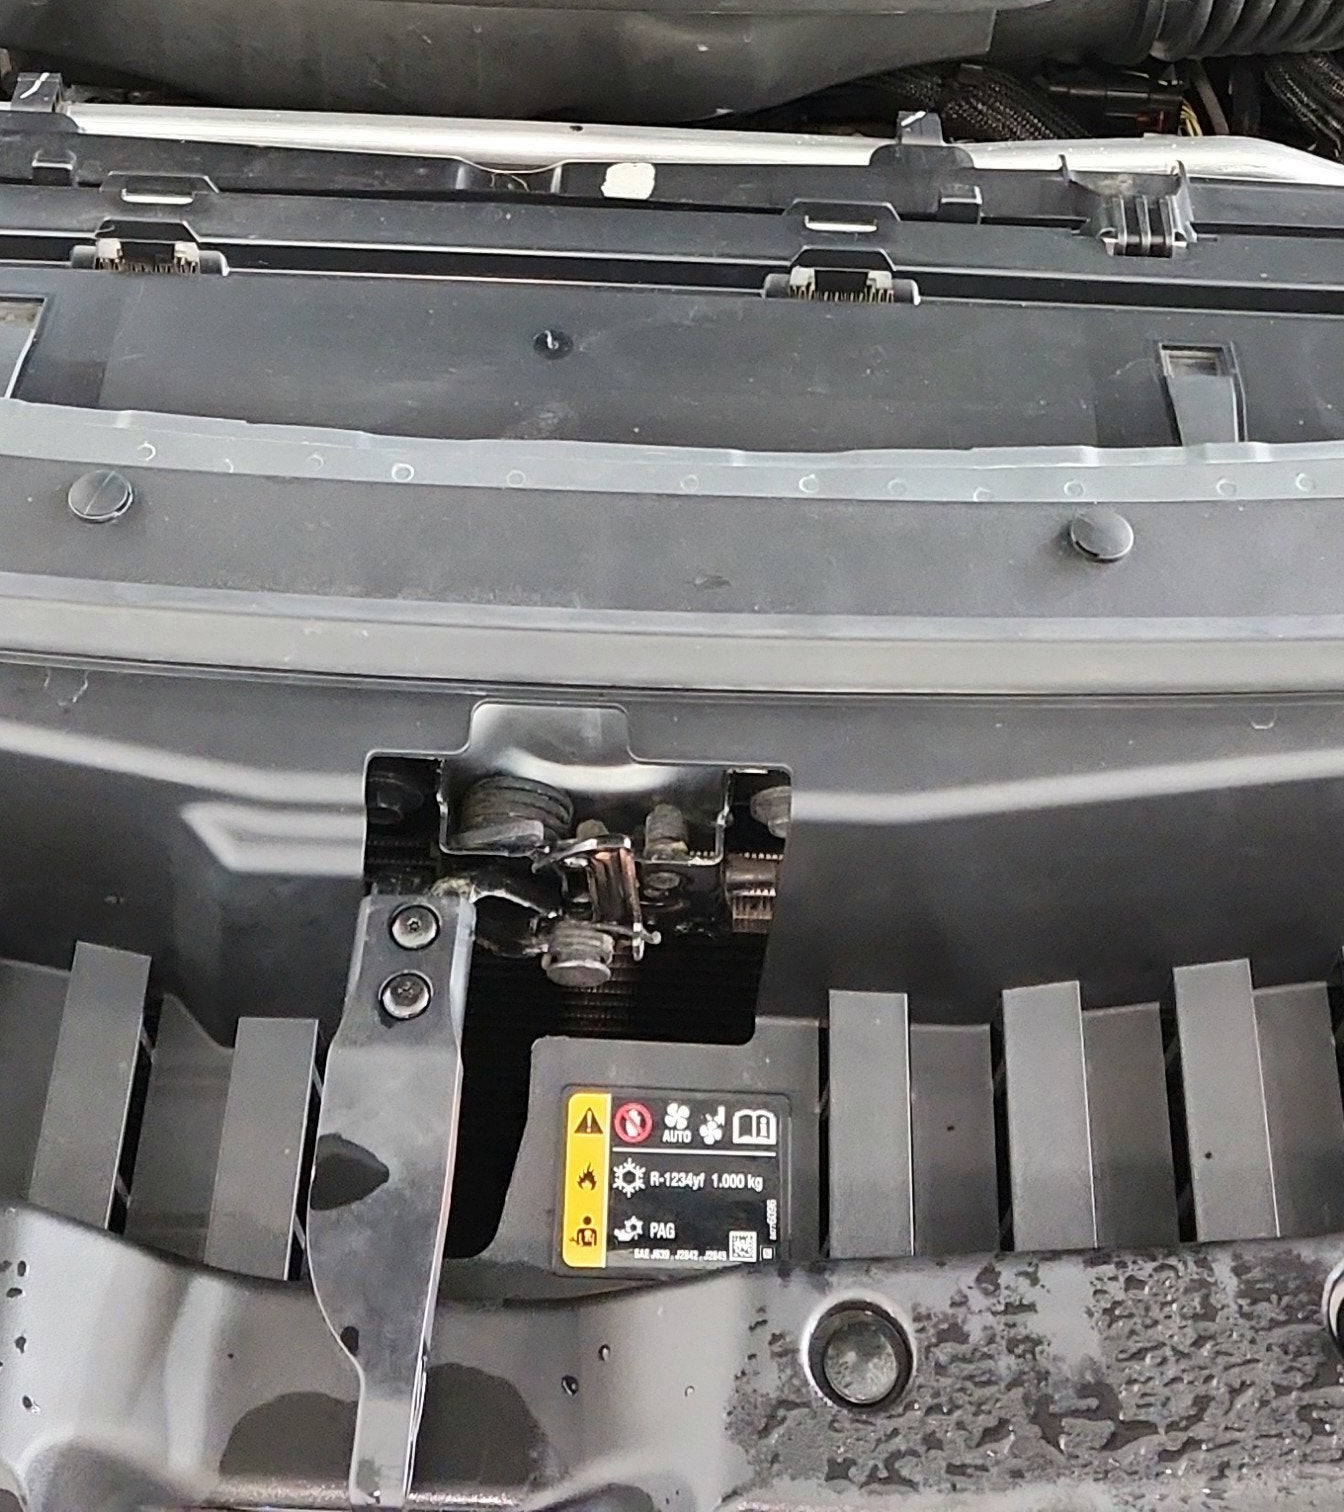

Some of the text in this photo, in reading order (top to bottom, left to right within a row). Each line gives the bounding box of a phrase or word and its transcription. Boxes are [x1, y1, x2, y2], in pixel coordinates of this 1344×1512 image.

[662, 1129, 692, 1144] AUTO
[649, 1171, 764, 1193] R-1234yf 1.000 kg
[649, 1221, 676, 1239] PAG
